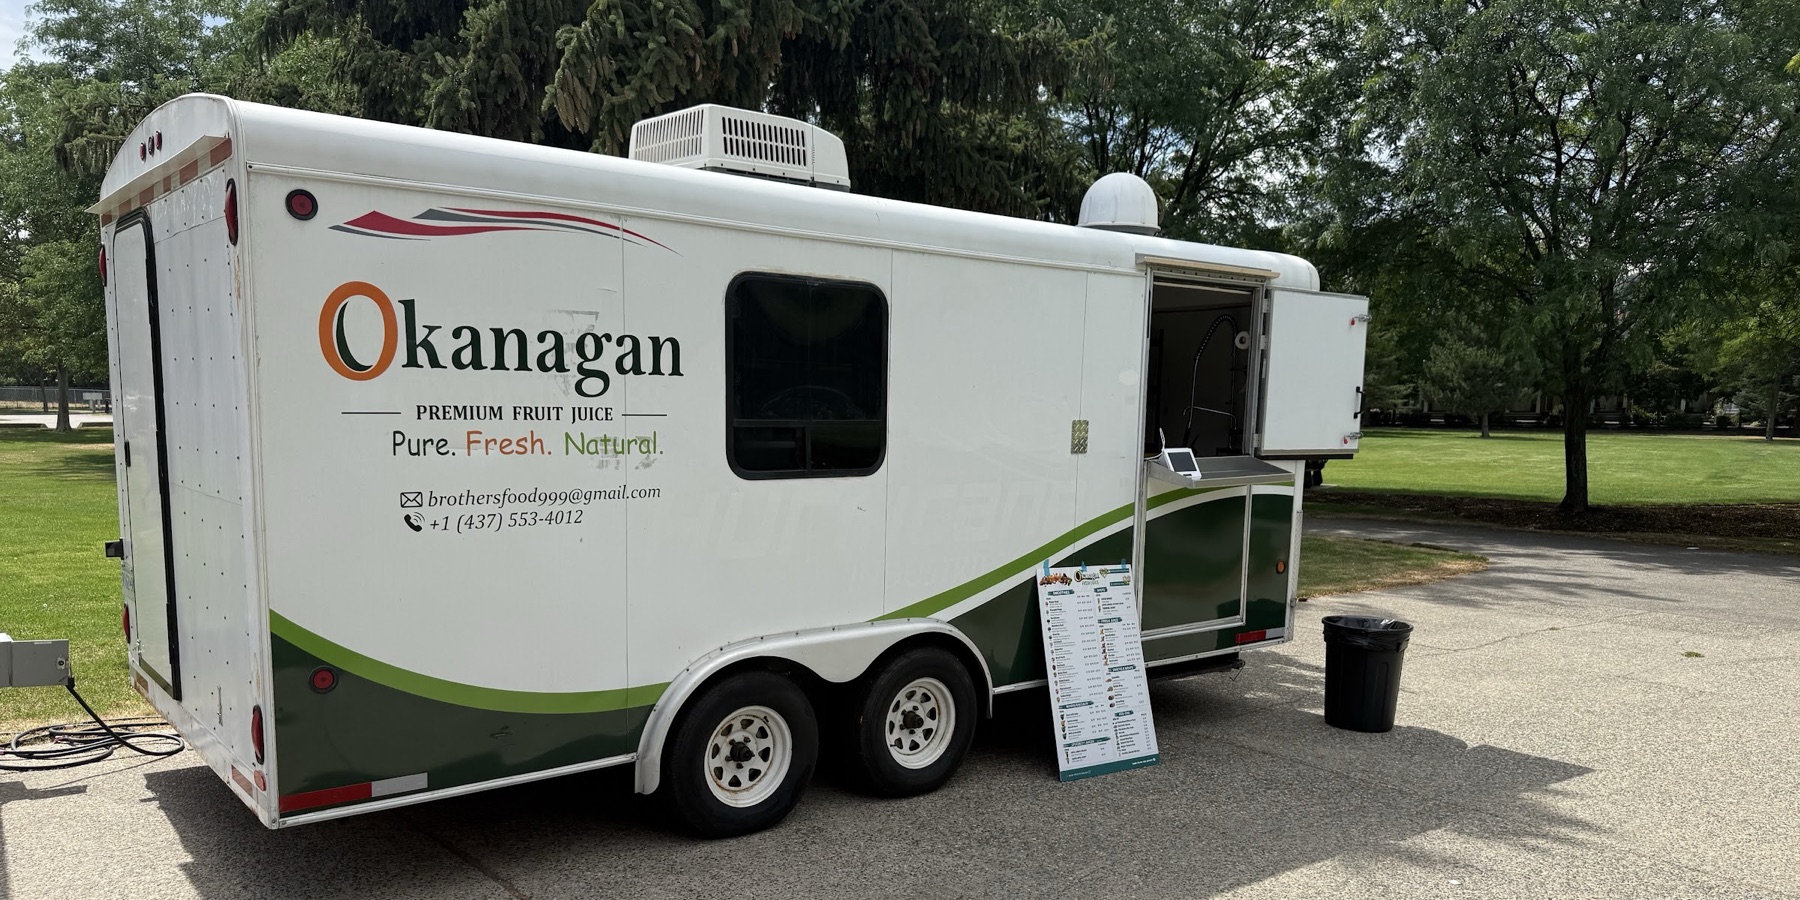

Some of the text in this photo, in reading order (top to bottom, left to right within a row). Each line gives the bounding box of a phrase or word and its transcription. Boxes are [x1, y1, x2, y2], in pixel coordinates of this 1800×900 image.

[318, 281, 684, 398] Okanagan
[416, 405, 613, 424] PREMIUM FRUIT JUICE
[392, 430, 664, 456] Pure. Fresh. Natural.
[427, 485, 661, 508] brothersfood999@gmail.com
[430, 509, 583, 535] +1 (437) 553-4012
